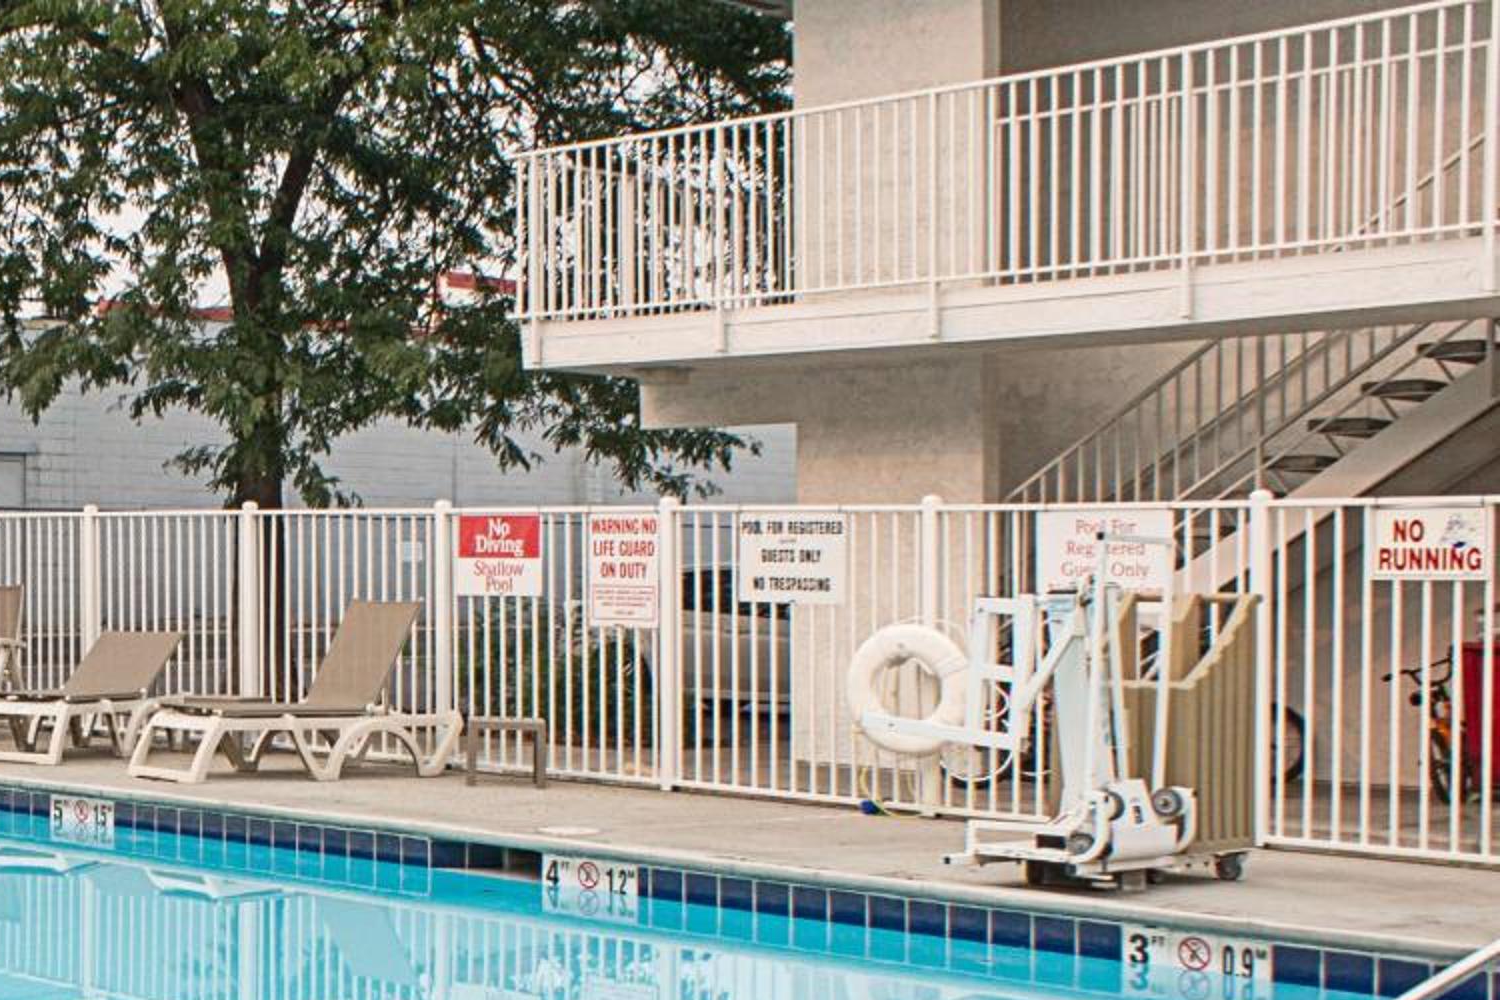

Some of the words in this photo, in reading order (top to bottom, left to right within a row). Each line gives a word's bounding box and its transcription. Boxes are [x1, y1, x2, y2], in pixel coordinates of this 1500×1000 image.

[488, 518, 510, 537] No
[591, 518, 639, 534] WARNING
[642, 518, 657, 534] NO
[742, 521, 762, 534] POOL
[767, 521, 783, 534] FOR
[787, 521, 842, 534] REGISTERED
[1392, 519, 1424, 542] NO
[475, 536, 524, 556] Diving
[593, 540, 615, 556] LIFE
[619, 540, 655, 556] GUARD
[761, 548, 795, 563] GUESTS
[799, 548, 821, 563] ONLY
[1379, 547, 1482, 571] RUNNING
[473, 560, 524, 576] Shallow
[600, 562, 616, 578] ON
[619, 562, 647, 578] DUTY
[485, 577, 513, 593] Pool
[753, 576, 765, 591] NO
[769, 576, 831, 592] TRESPASSING
[546, 861, 559, 886] 4
[1129, 934, 1149, 963] 3
